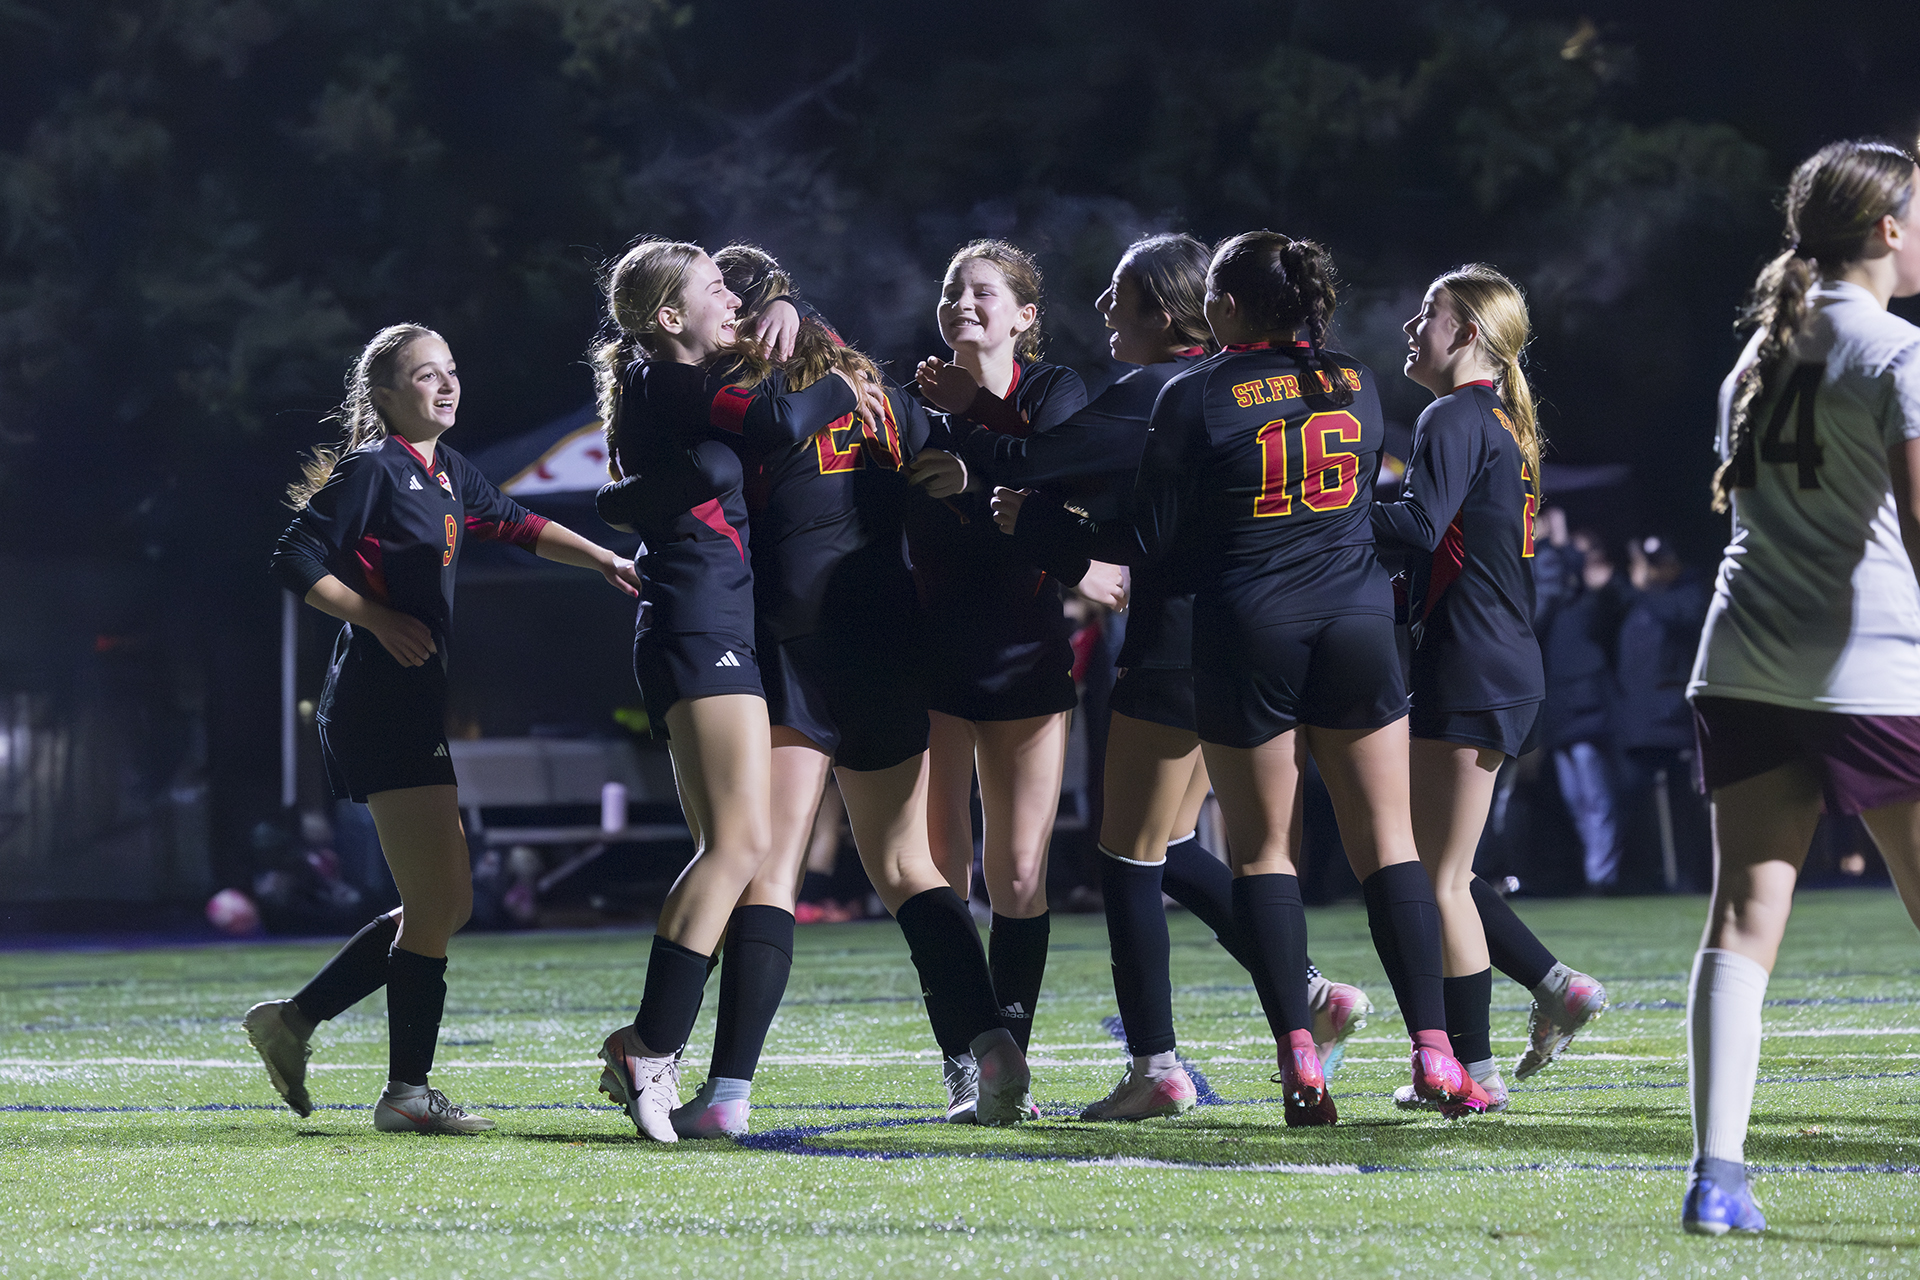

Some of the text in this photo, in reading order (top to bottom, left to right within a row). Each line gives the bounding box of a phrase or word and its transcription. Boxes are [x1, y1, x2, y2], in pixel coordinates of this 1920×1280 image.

[1232, 367, 1362, 408] ST.FRAS
[1253, 410, 1361, 517] 16
[443, 514, 457, 567] 9
